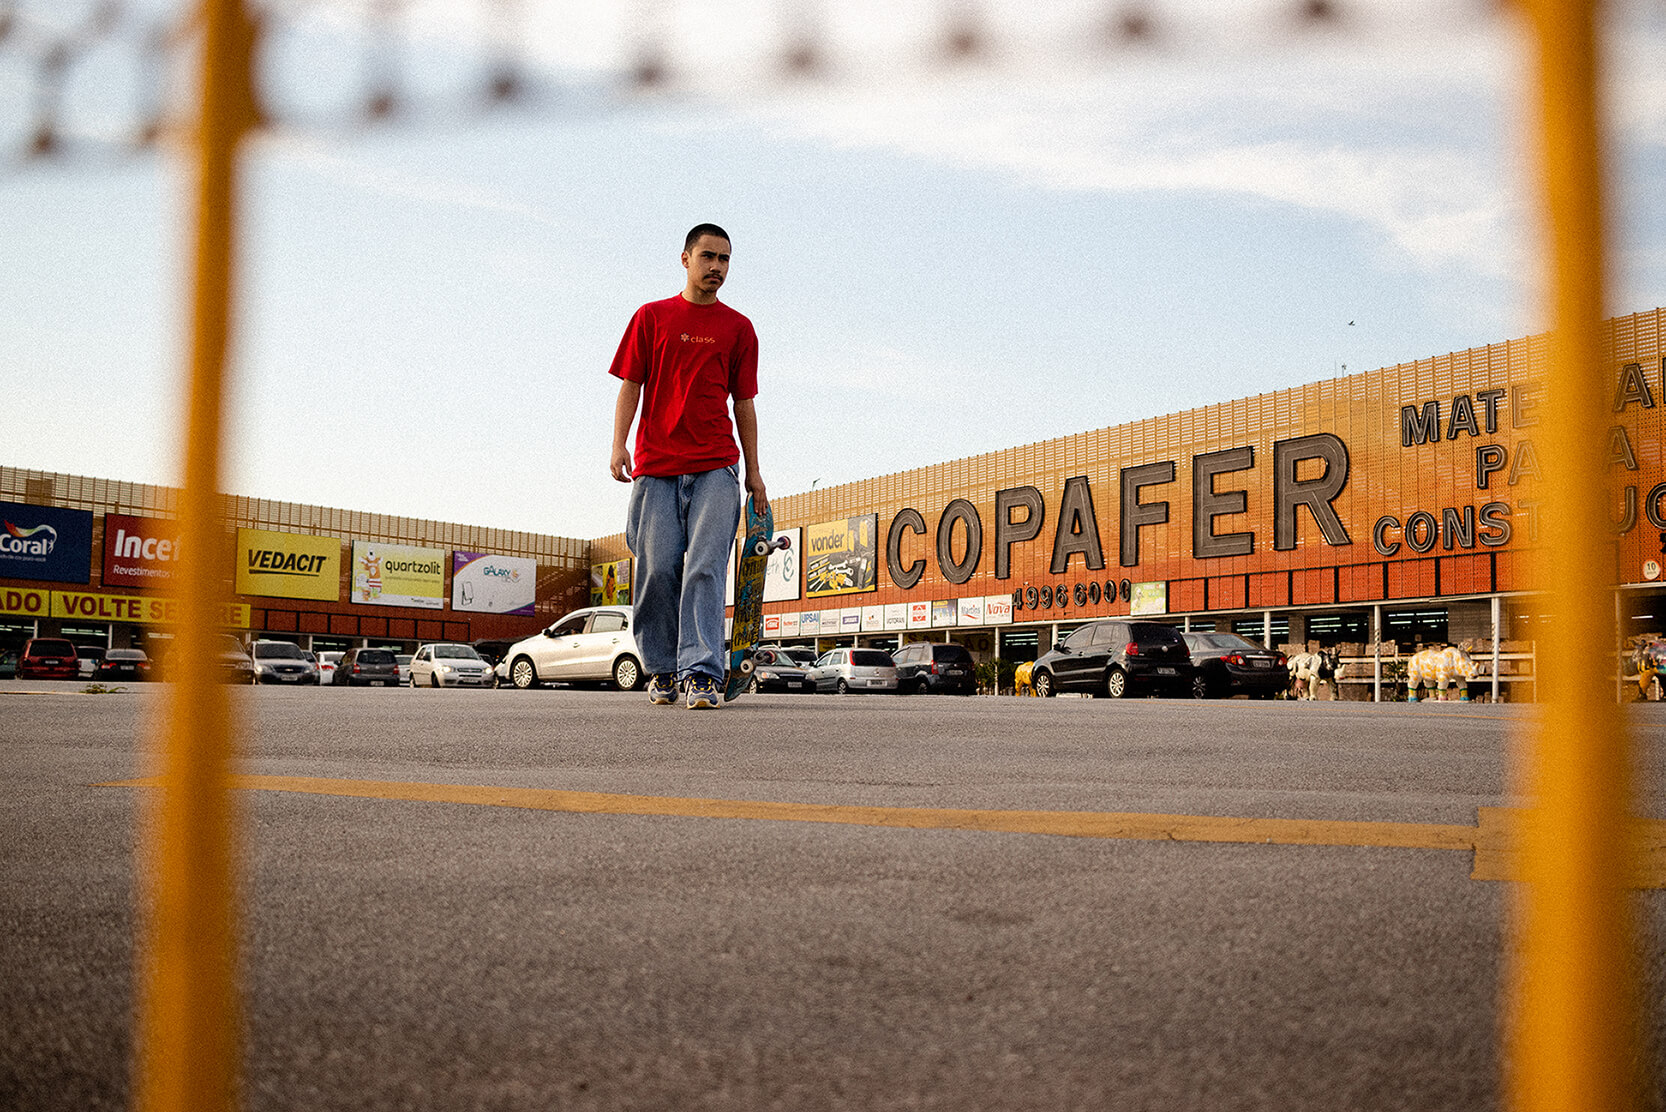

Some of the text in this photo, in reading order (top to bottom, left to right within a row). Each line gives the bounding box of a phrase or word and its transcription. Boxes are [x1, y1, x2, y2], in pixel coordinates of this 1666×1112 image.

[690, 335, 716, 344] class
[1476, 425, 1639, 489] PAA
[886, 433, 1352, 590] COPAFER
[0, 533, 48, 555] Coral
[811, 529, 845, 553] vonder
[113, 564, 171, 579] Revestimentos
[248, 549, 327, 574] VEDACIT
[385, 560, 441, 575] quartzolit
[1647, 562, 1657, 571] 10
[0, 590, 42, 613] DO
[1012, 577, 1132, 611] 4996 6000
[62, 594, 142, 619] VOLTE
[986, 603, 1011, 616] Nova
